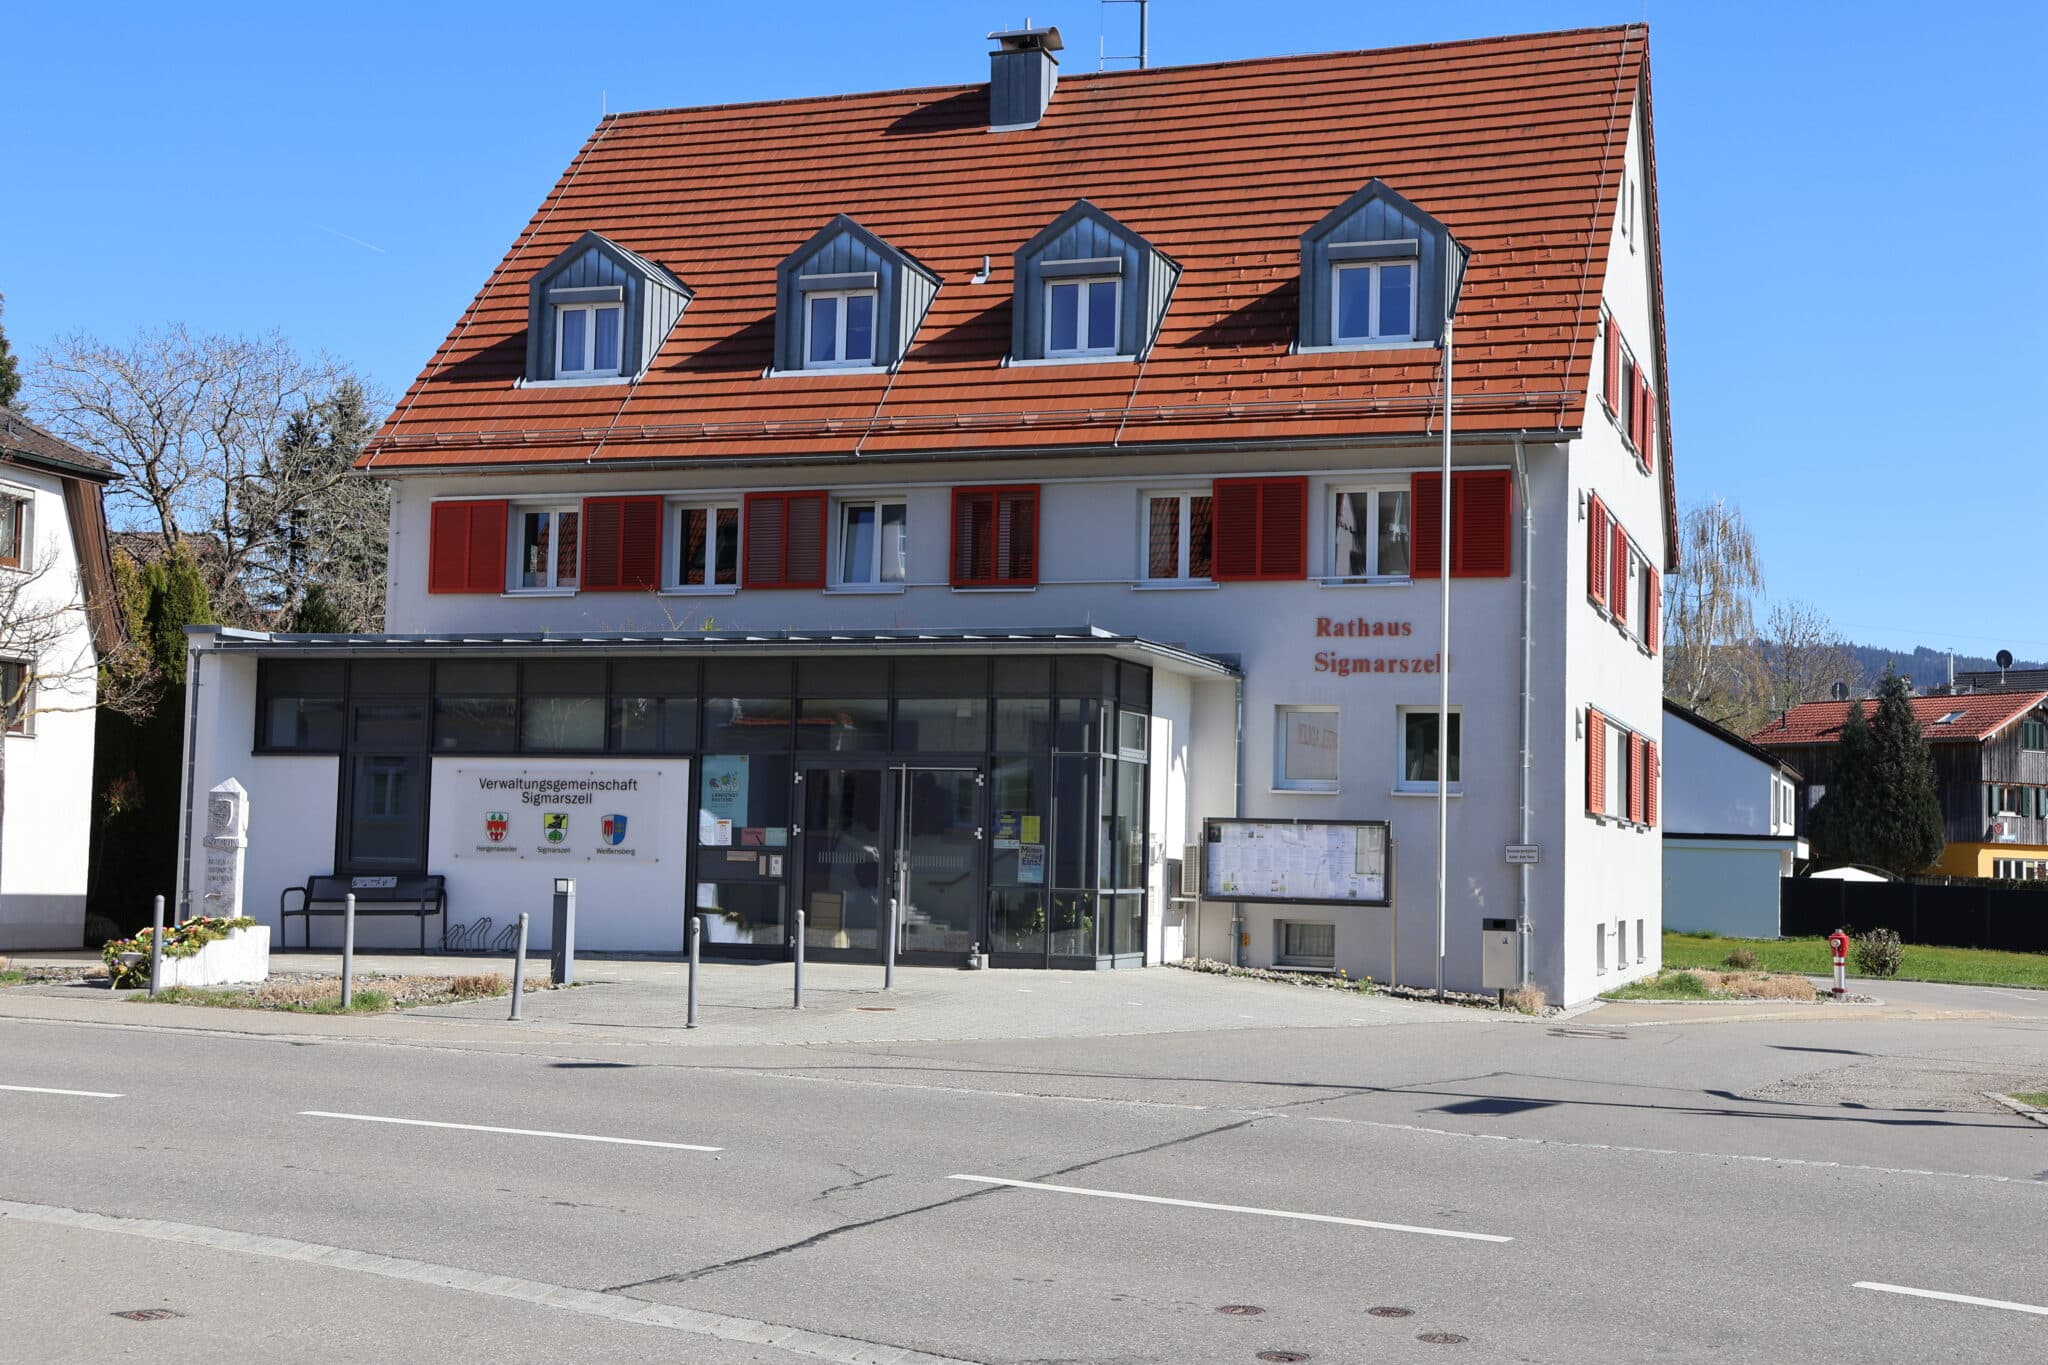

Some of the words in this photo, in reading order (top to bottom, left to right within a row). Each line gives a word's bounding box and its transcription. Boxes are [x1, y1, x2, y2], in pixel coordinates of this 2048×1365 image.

[1316, 617, 1412, 637] Rathaus
[479, 778, 638, 791] Verwaltungsgemeinschaft
[521, 791, 593, 806] Sigmarszell
